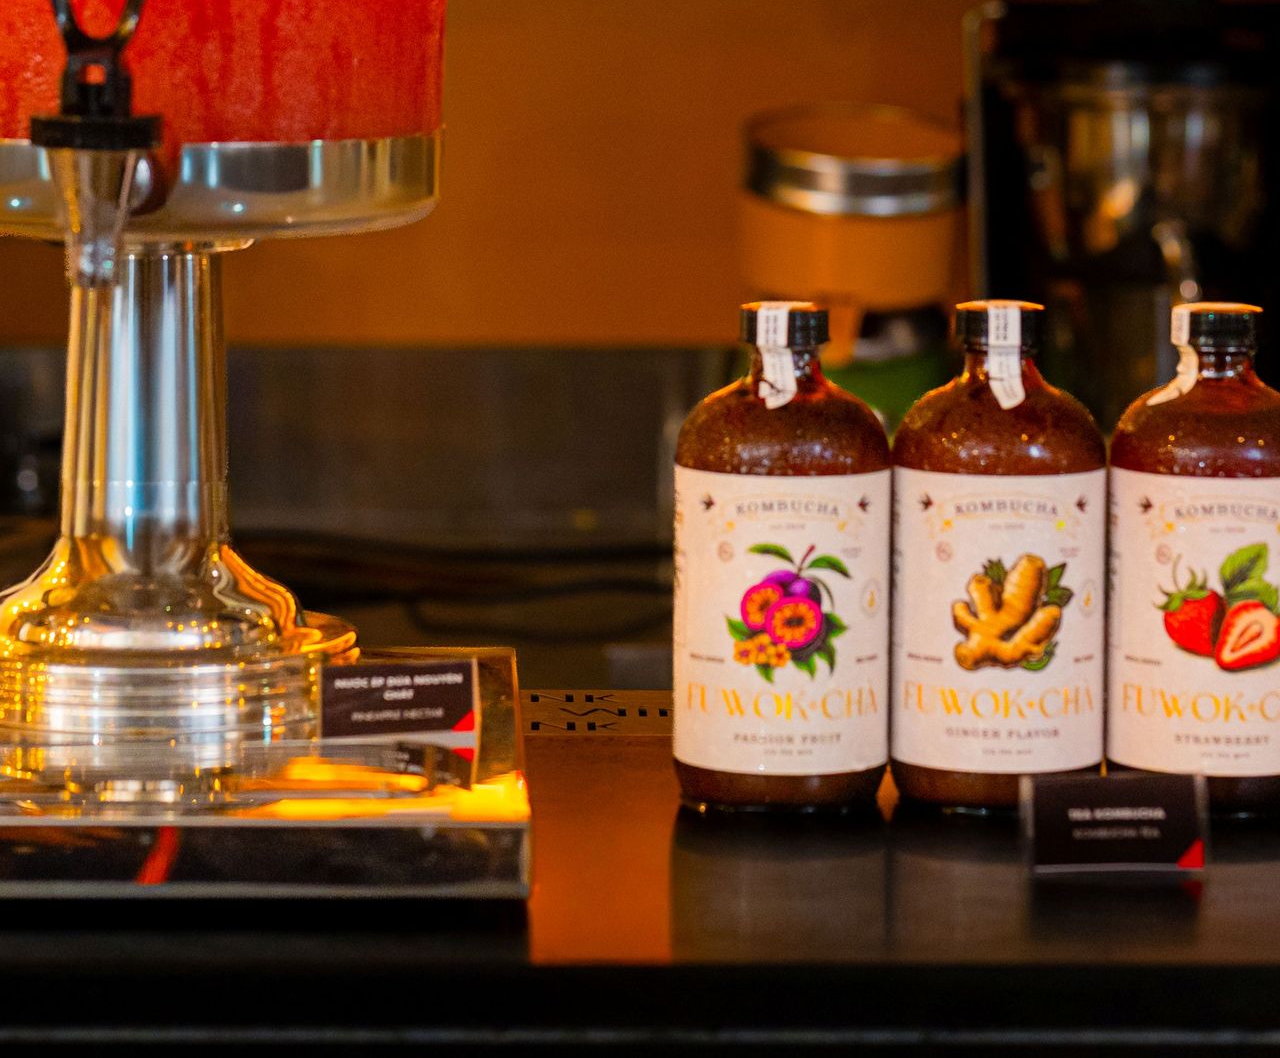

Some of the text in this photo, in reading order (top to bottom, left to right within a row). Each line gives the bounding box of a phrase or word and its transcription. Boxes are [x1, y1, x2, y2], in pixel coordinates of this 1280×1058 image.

[735, 498, 840, 517] KOMBUCHA
[954, 498, 1059, 516] KOMBUCHA
[1173, 501, 1280, 520] KOMBUCHA
[733, 733, 842, 744] PASSION FRUIT
[945, 726, 1060, 740] GINGER FLAVOR
[1174, 734, 1271, 746] STRAWBERRY
